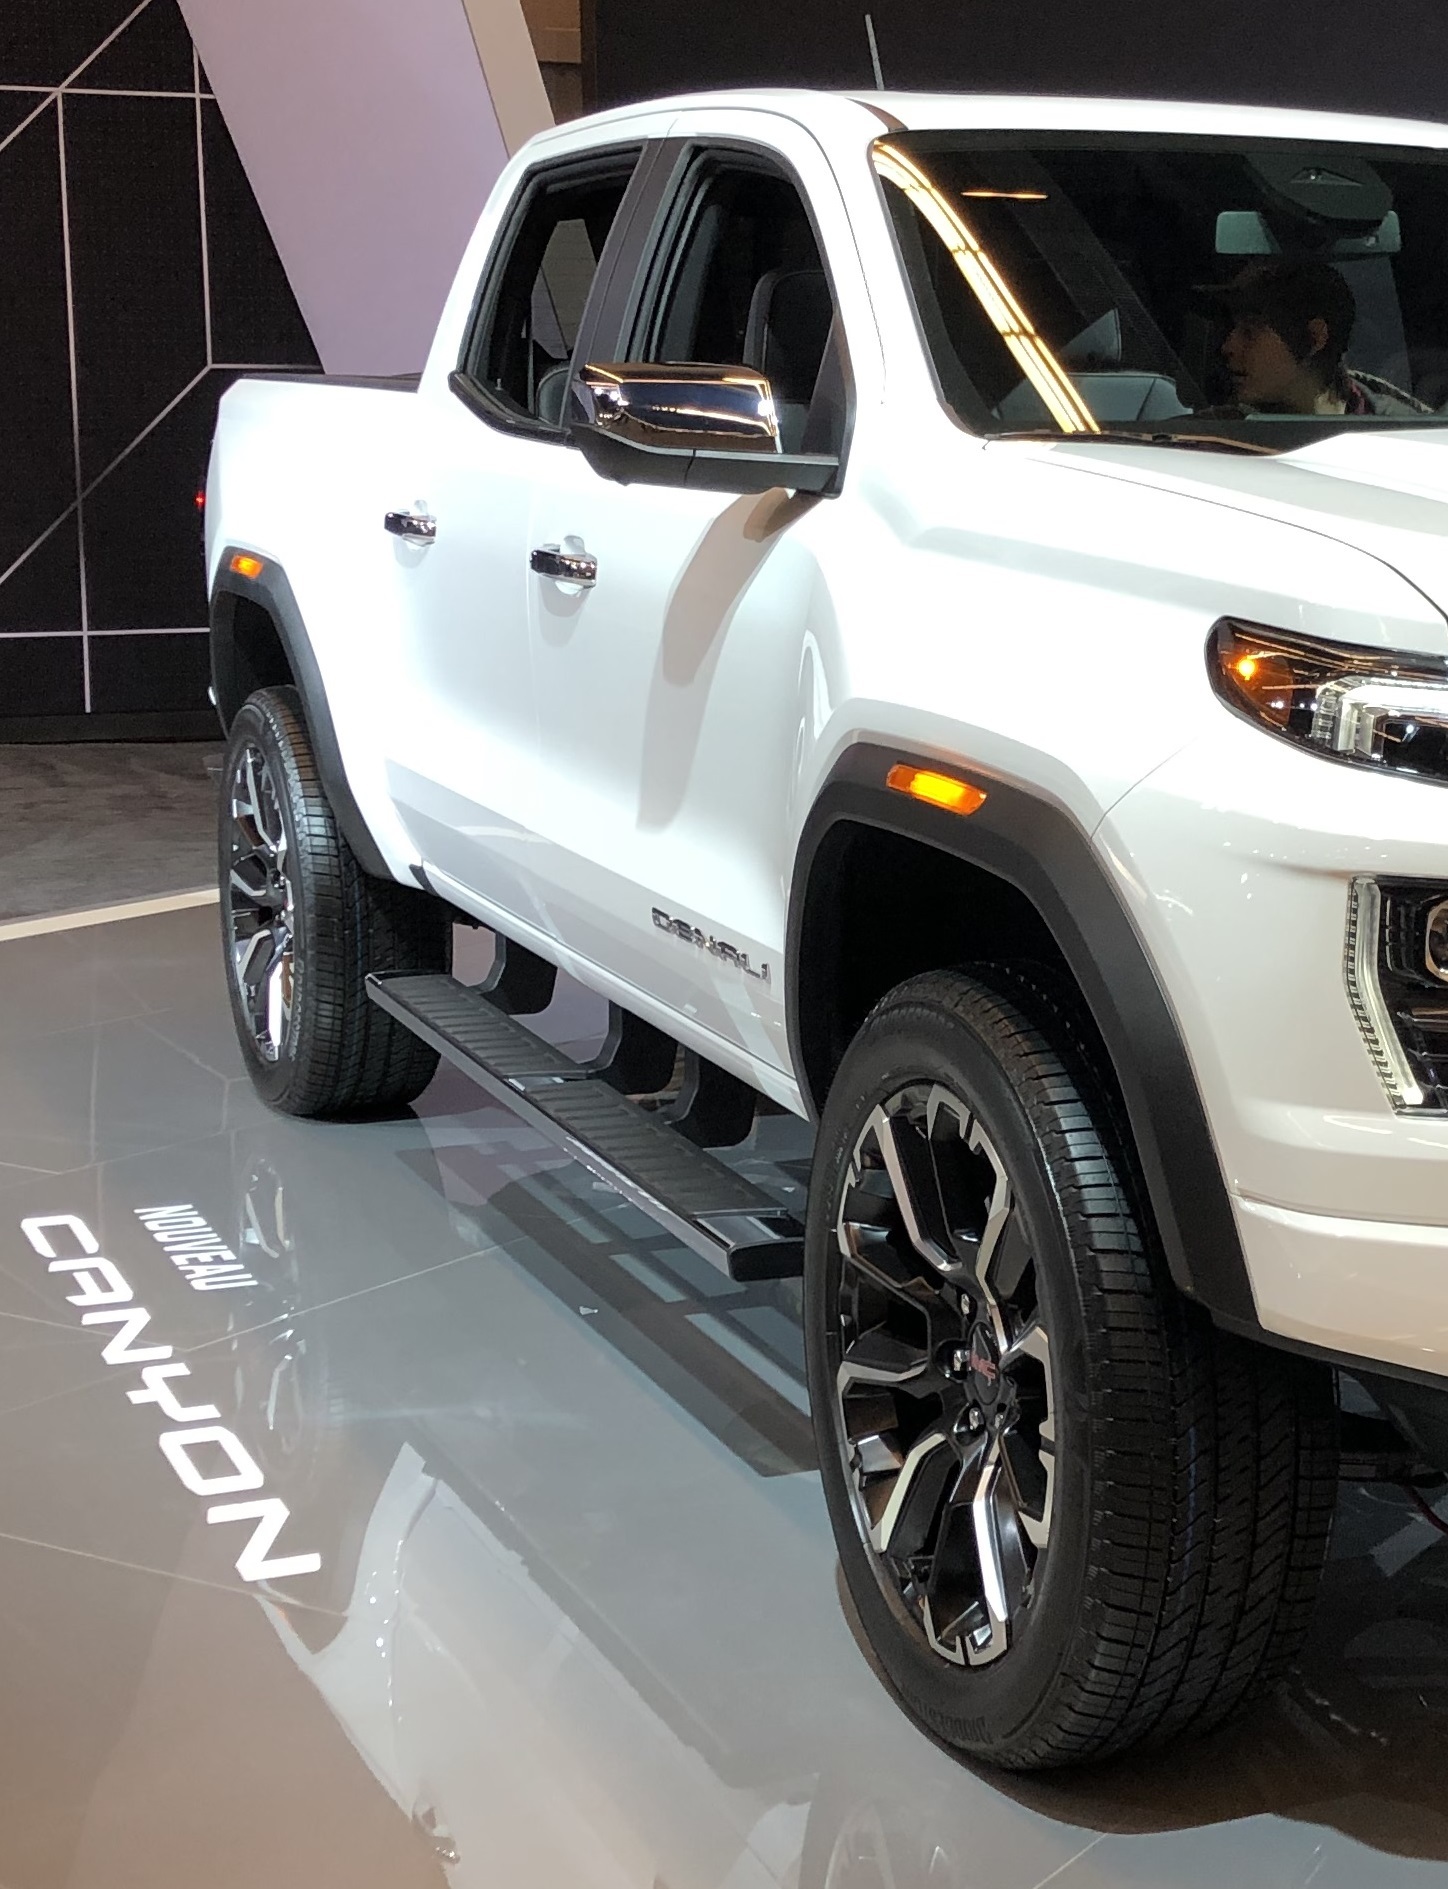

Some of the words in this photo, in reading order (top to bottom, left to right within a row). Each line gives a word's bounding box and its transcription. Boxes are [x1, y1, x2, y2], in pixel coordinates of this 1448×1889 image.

[652, 907, 771, 985] DENALI
[133, 1204, 258, 1291] NOUVEAU
[20, 1214, 322, 1582] CANYON
